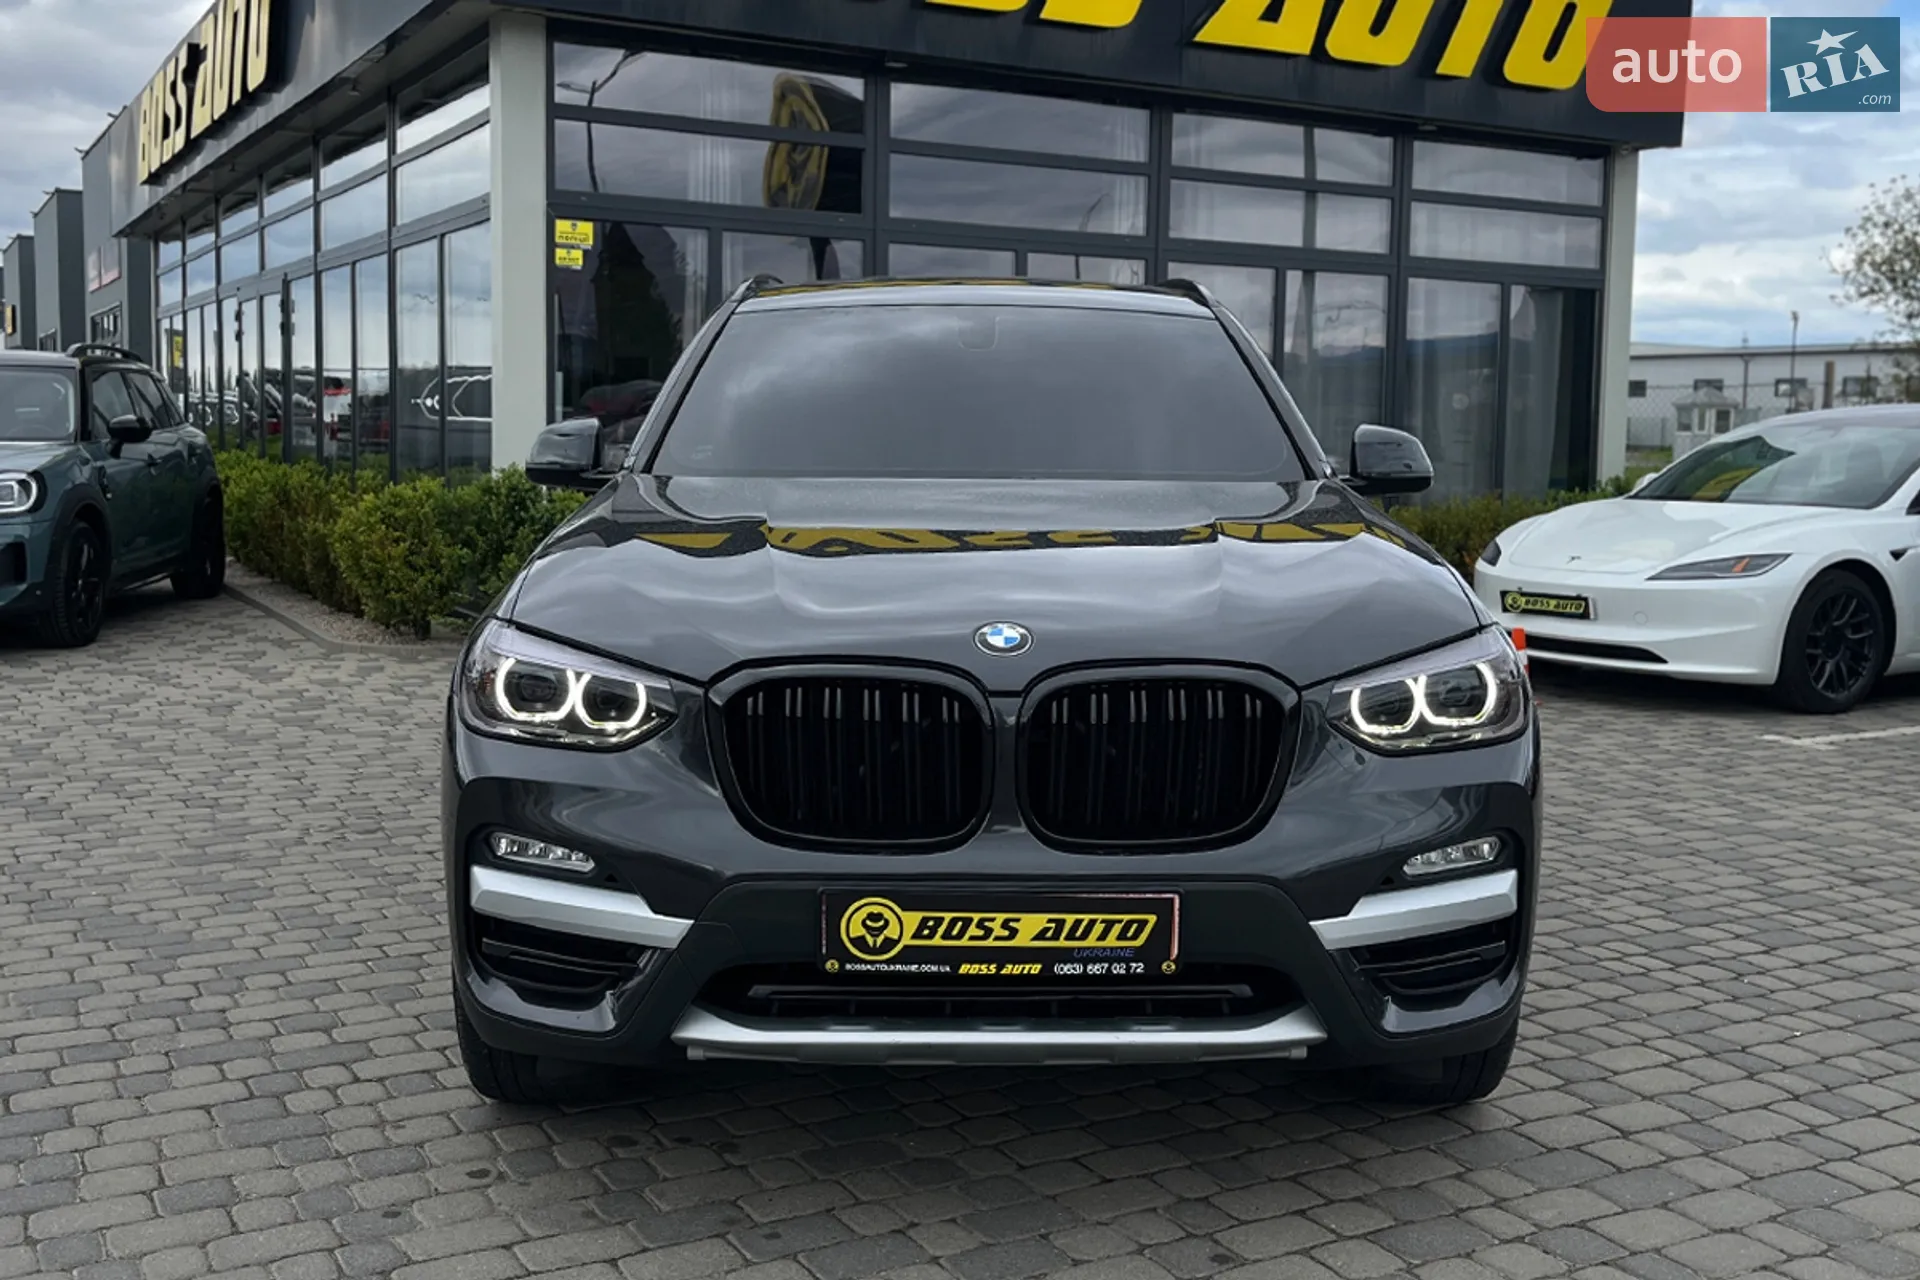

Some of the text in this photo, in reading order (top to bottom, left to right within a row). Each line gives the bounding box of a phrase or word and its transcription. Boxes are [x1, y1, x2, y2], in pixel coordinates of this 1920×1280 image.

[137, 0, 270, 185] BOSS AUTO
[1524, 598, 1583, 611] BOSS AUTO
[910, 916, 1150, 942] BOSS AUTO
[1073, 948, 1135, 957] UKRAINE
[958, 963, 1042, 974] BOSS AUTO
[1129, 963, 1145, 974] 72
